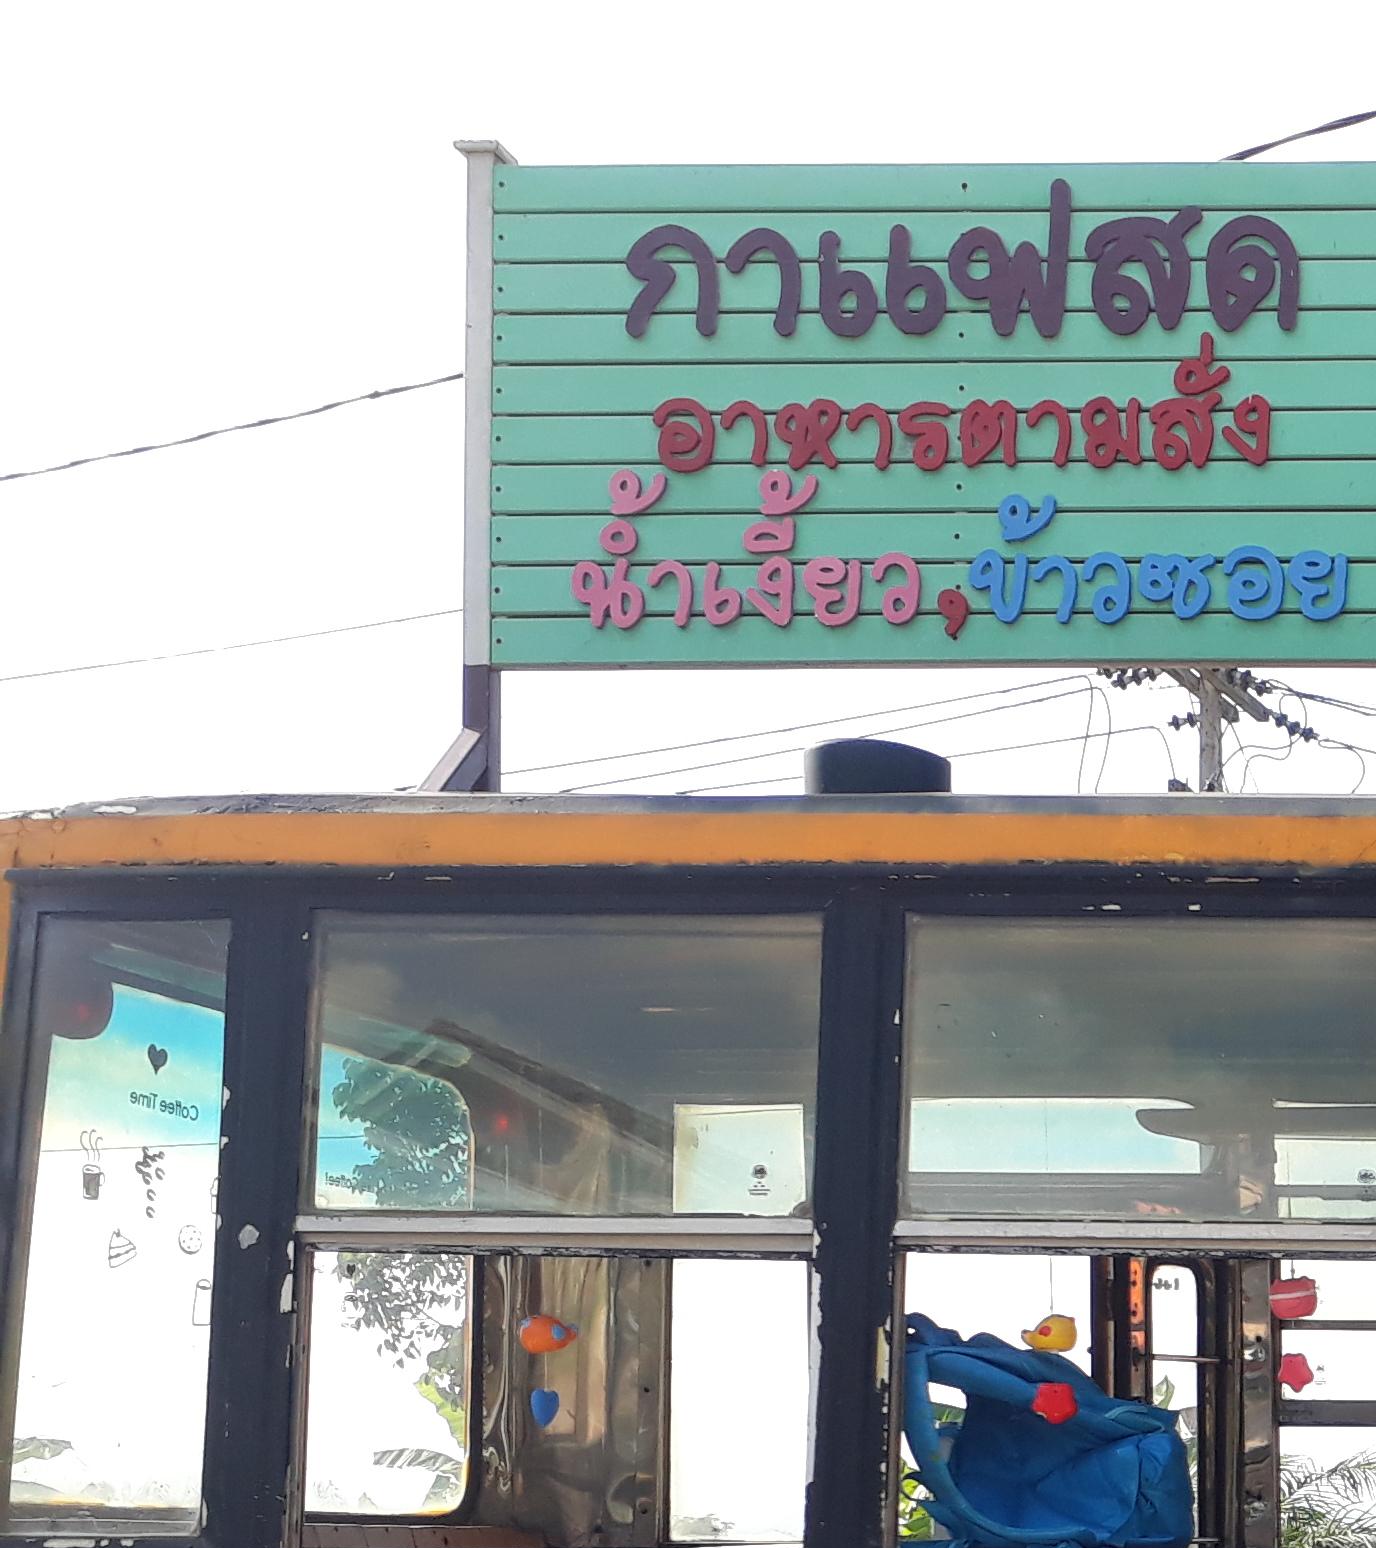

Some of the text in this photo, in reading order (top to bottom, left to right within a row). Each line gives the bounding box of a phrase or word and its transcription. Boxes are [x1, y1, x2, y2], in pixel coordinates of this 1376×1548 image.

[624, 178, 1301, 337] กาแฟสด
[652, 331, 1272, 471] อาหารตามสั่ง
